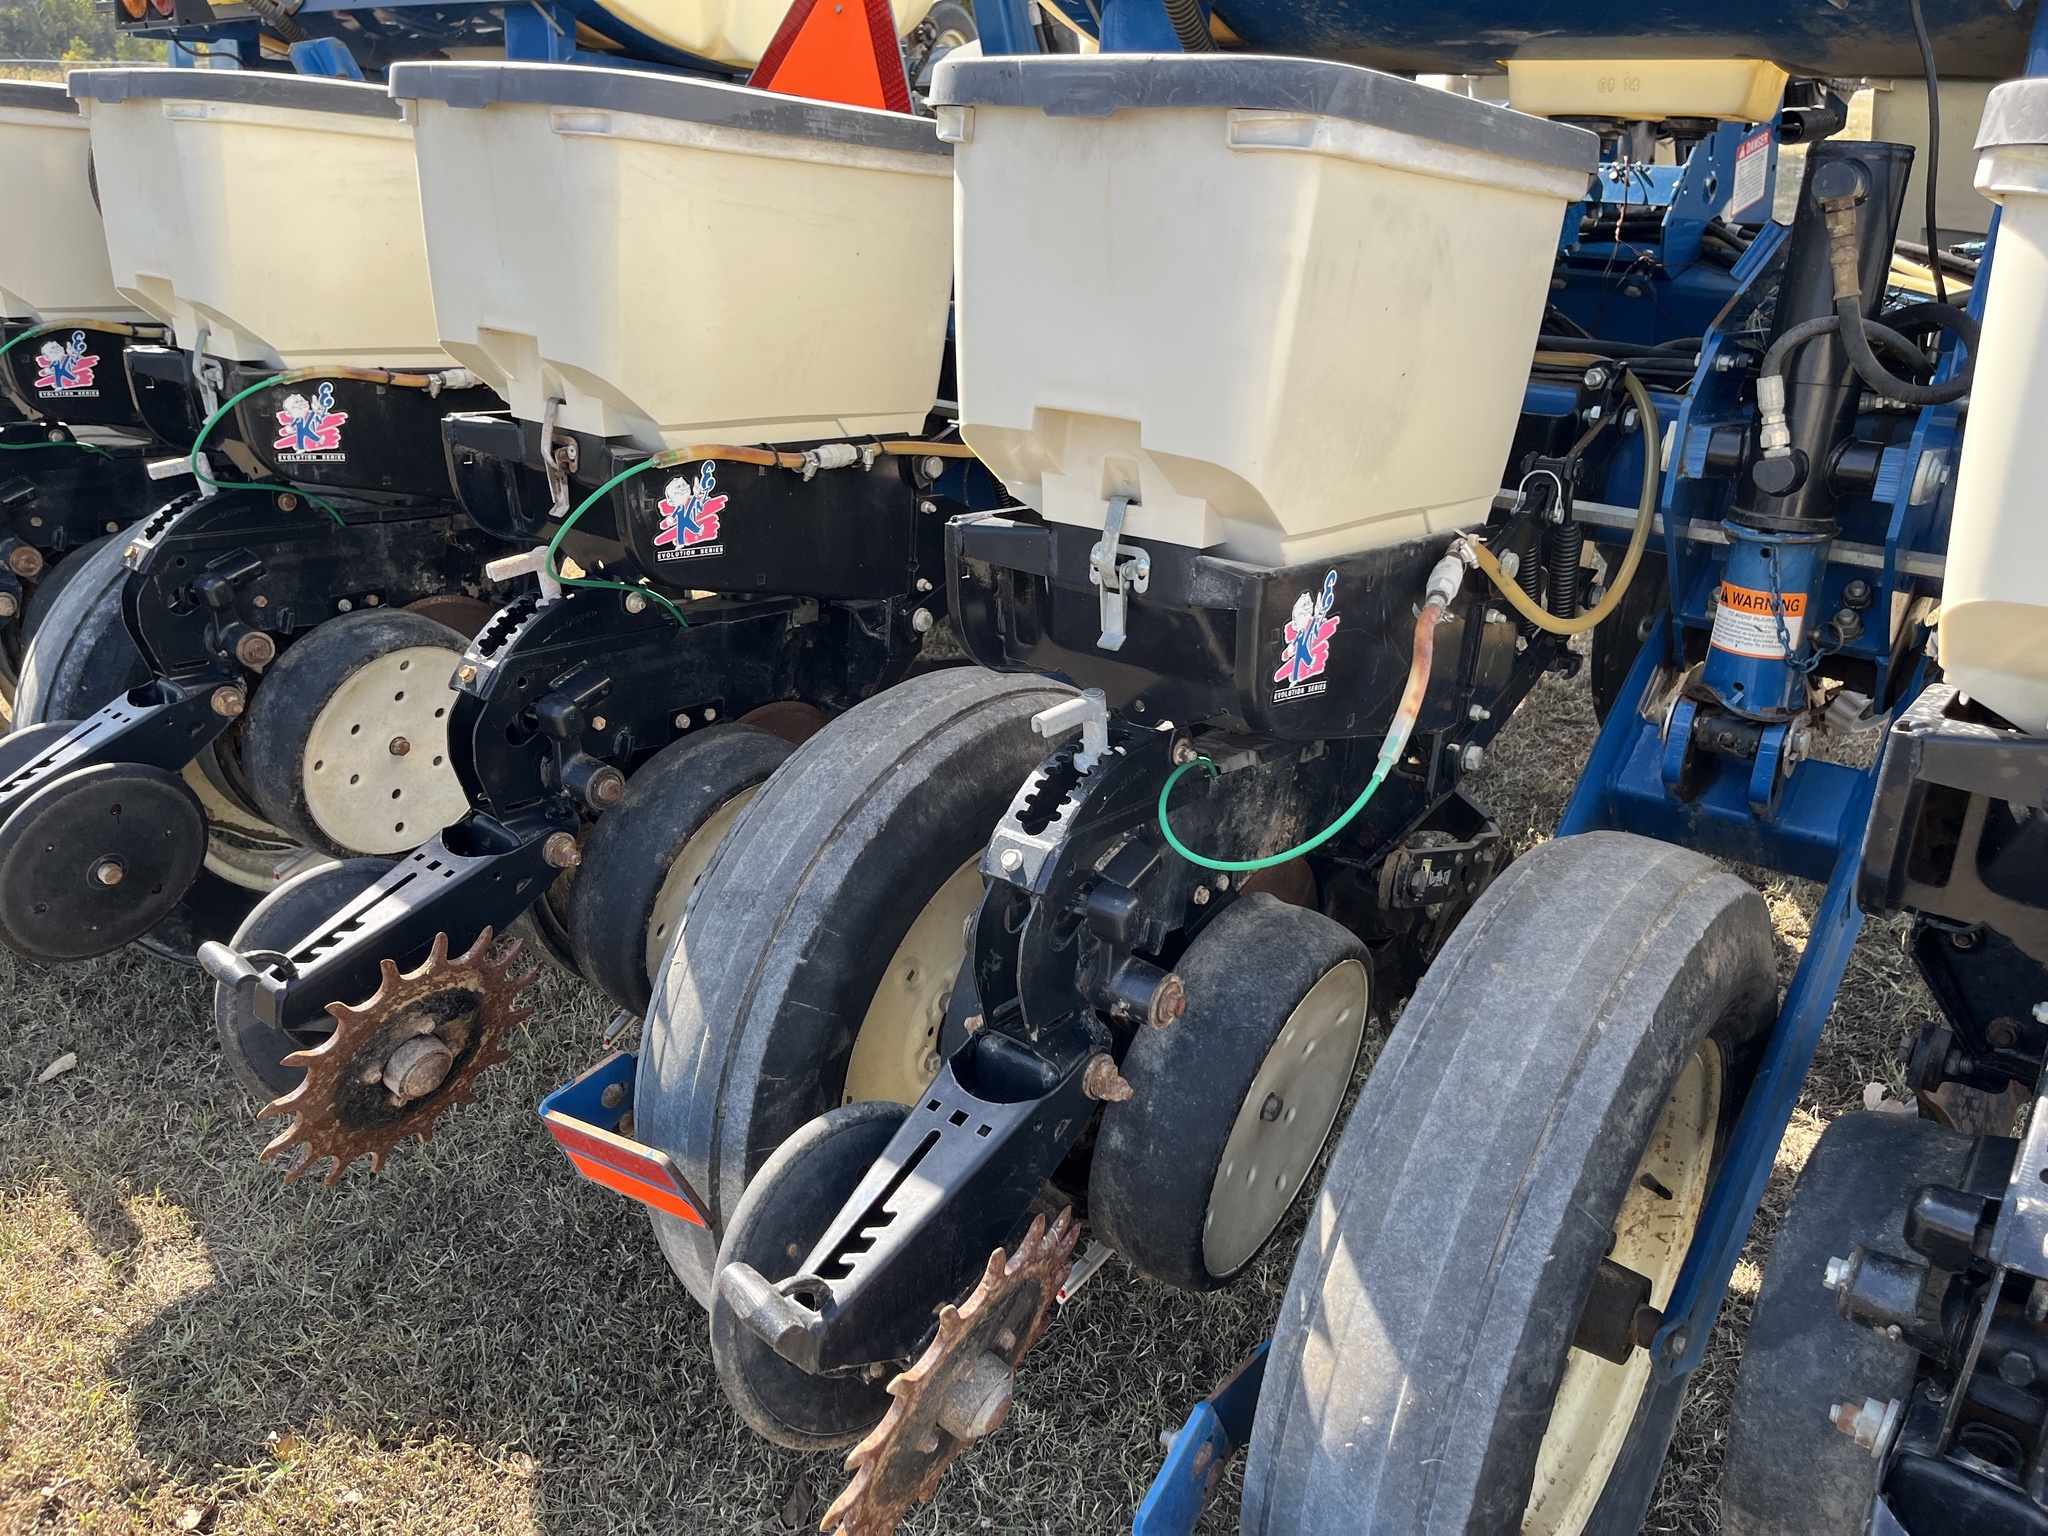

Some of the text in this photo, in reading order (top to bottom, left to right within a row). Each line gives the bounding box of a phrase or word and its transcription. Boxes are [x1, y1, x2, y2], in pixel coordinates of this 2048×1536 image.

[657, 545, 724, 559] EVOLUTION SERIES
[1273, 682, 1327, 700] EVOLUTION SERIES
